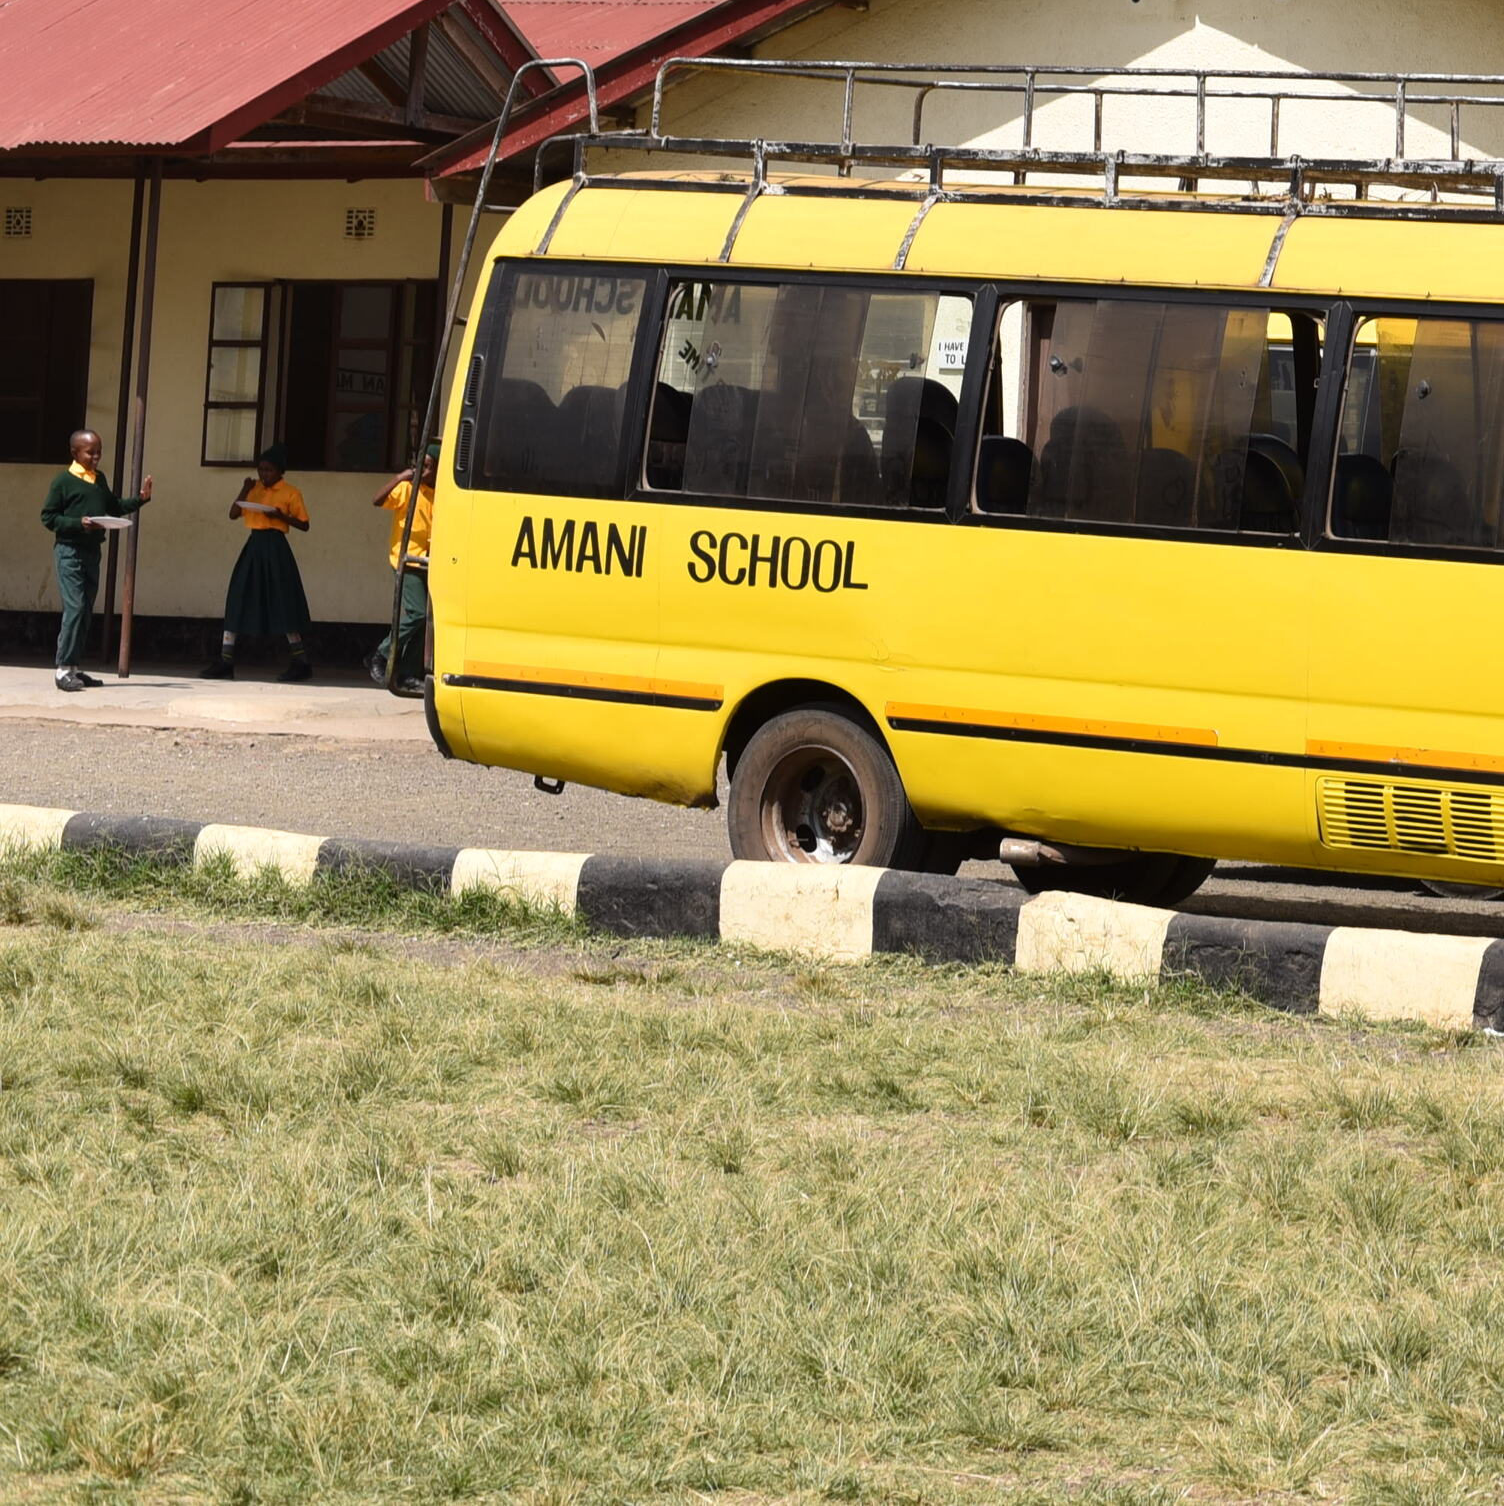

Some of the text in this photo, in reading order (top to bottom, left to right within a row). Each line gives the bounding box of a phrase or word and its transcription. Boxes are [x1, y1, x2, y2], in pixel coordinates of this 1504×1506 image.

[944, 342, 965, 352] HAVE
[945, 354, 956, 365] TO
[511, 516, 868, 593] AMANI SCHOOL
